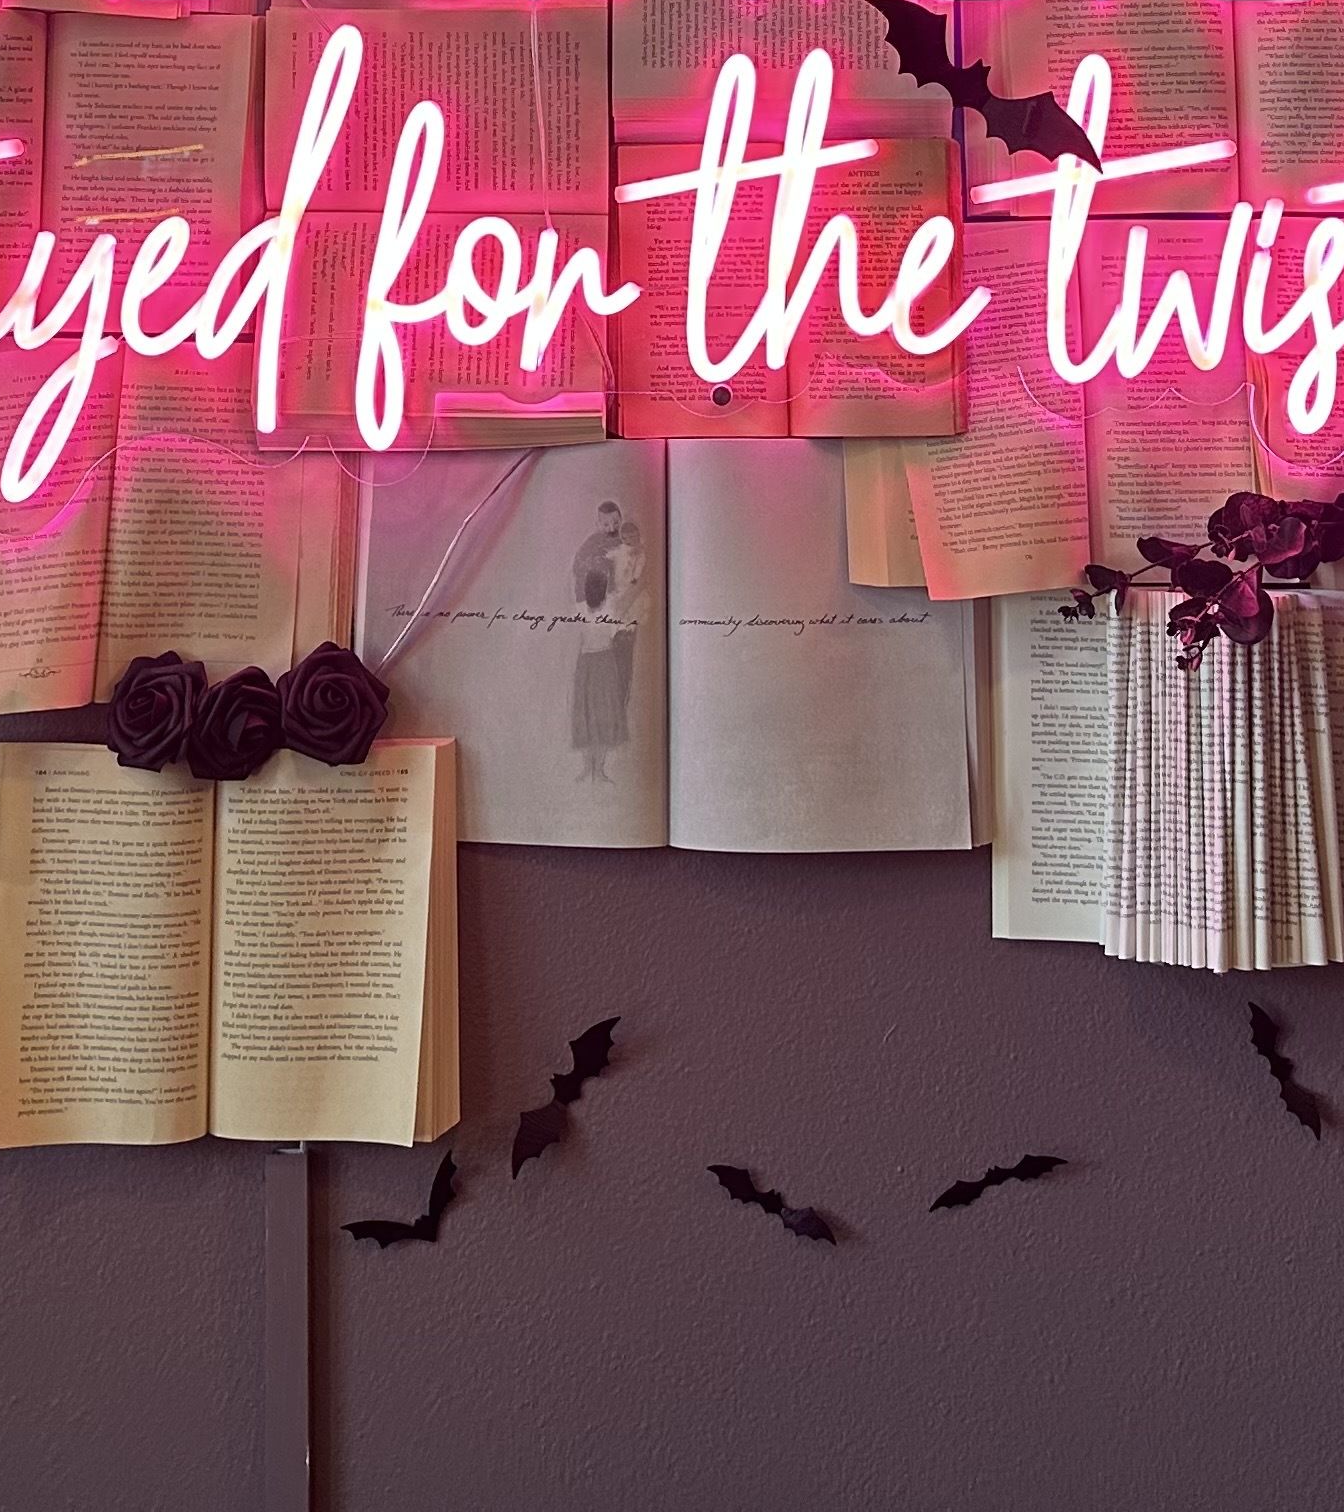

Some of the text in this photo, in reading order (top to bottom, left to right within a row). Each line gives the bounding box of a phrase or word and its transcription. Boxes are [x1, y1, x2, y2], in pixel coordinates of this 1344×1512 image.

[356, 100, 641, 452] for
[615, 48, 992, 384] the
[487, 607, 507, 629] for
[512, 609, 545, 630] change
[547, 611, 591, 632] greater
[595, 614, 625, 626] than
[744, 614, 806, 636] discovering
[809, 613, 837, 625] what
[838, 614, 855, 625] it
[856, 615, 883, 625] cares
[888, 611, 933, 625] about
